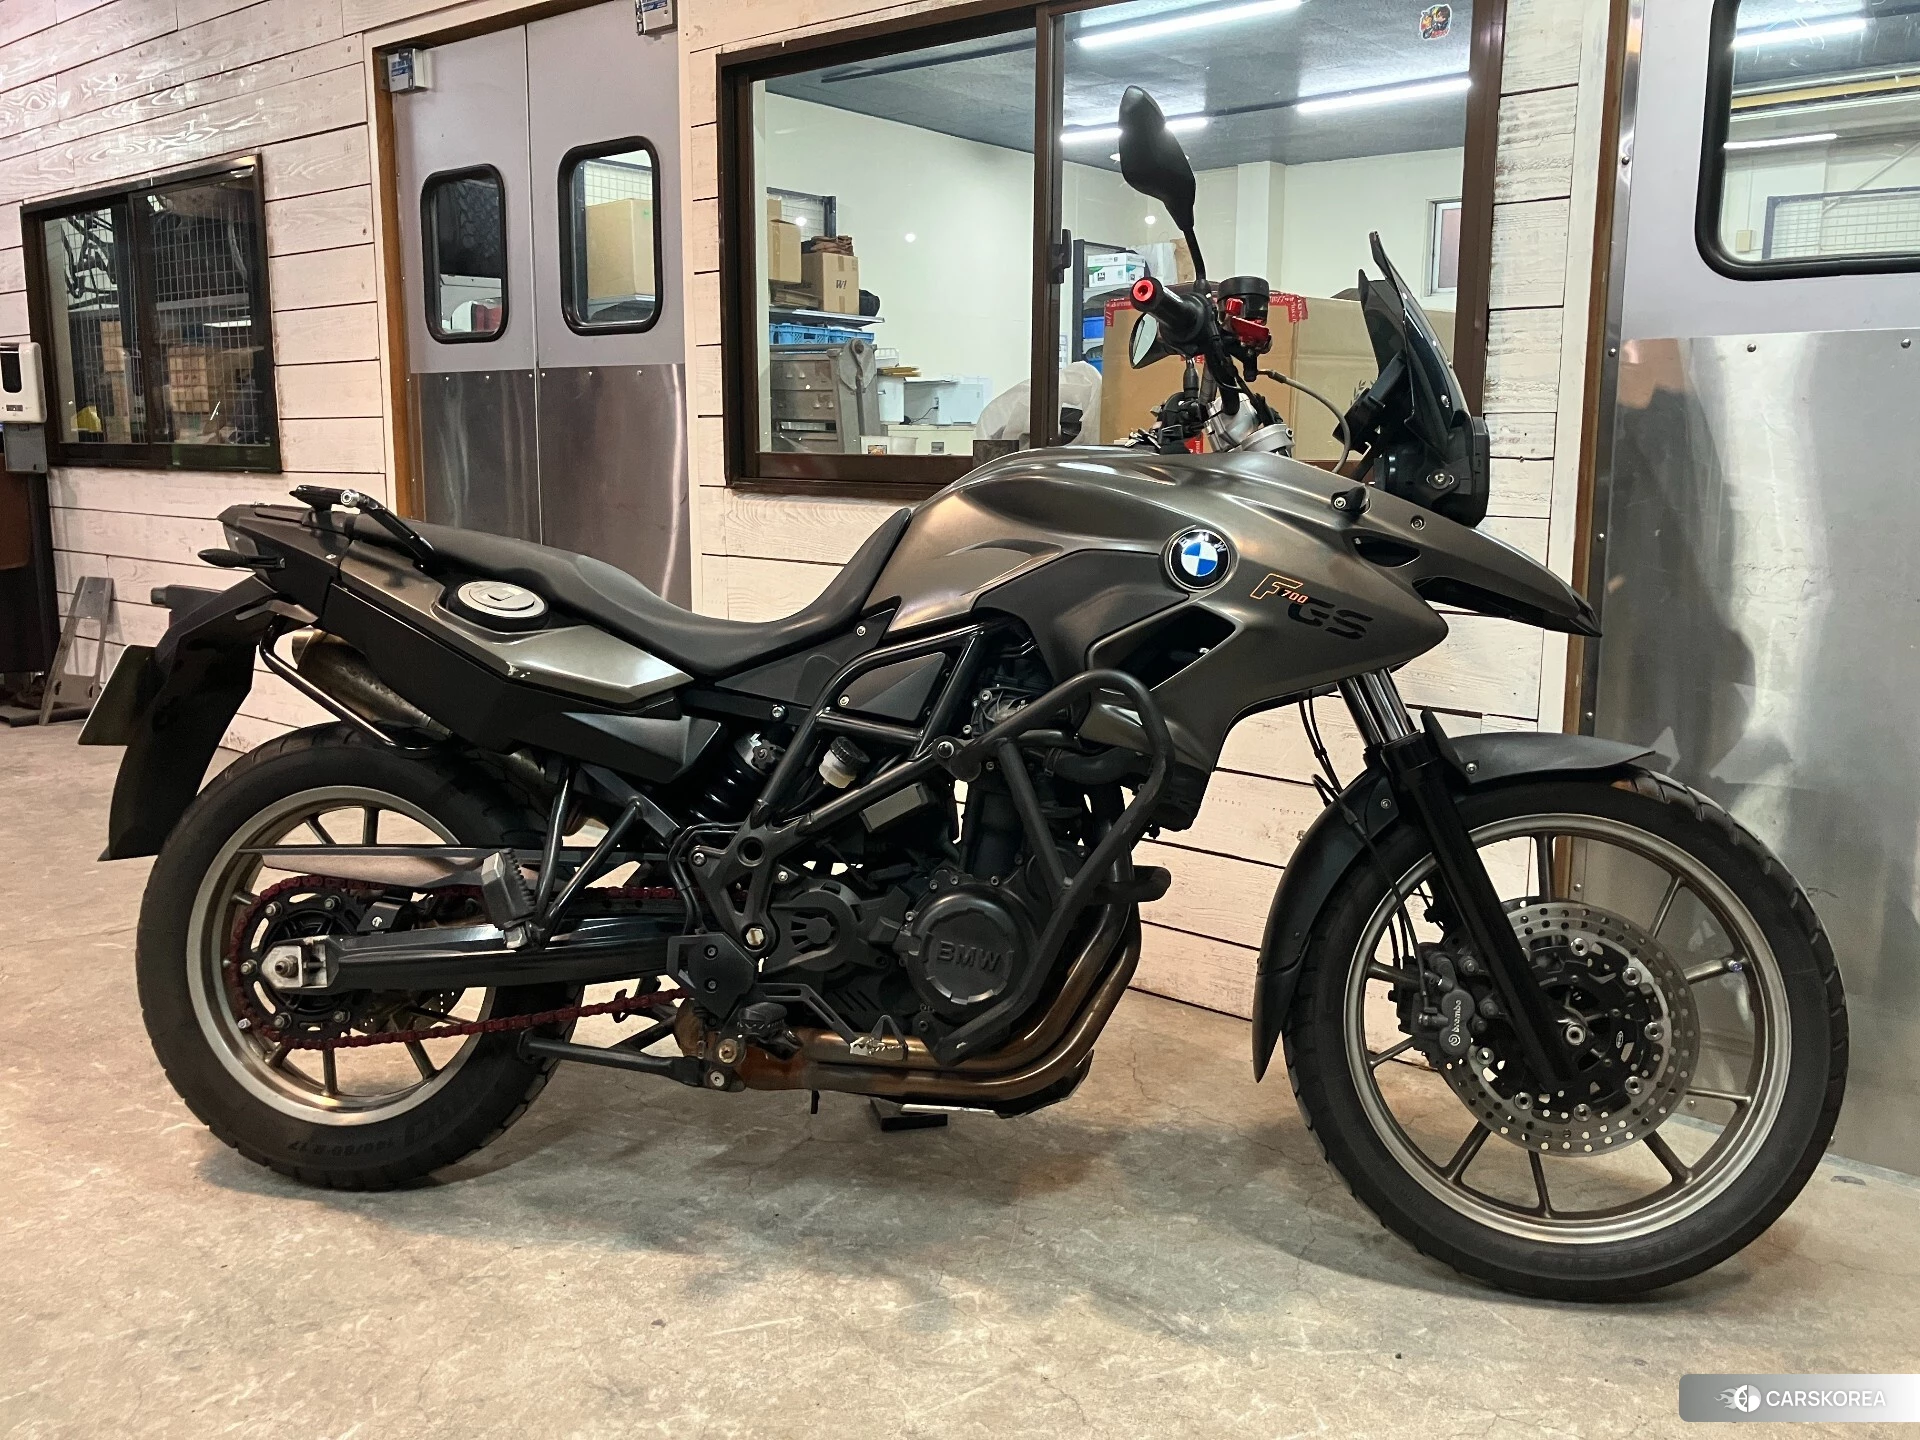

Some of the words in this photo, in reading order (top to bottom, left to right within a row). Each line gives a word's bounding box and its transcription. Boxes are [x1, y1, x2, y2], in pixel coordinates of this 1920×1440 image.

[1249, 573, 1303, 600] F
[1281, 589, 1308, 604] 700
[1287, 597, 1374, 640] GS
[938, 940, 1001, 972] BMW
[1452, 1000, 1461, 1033] brembo
